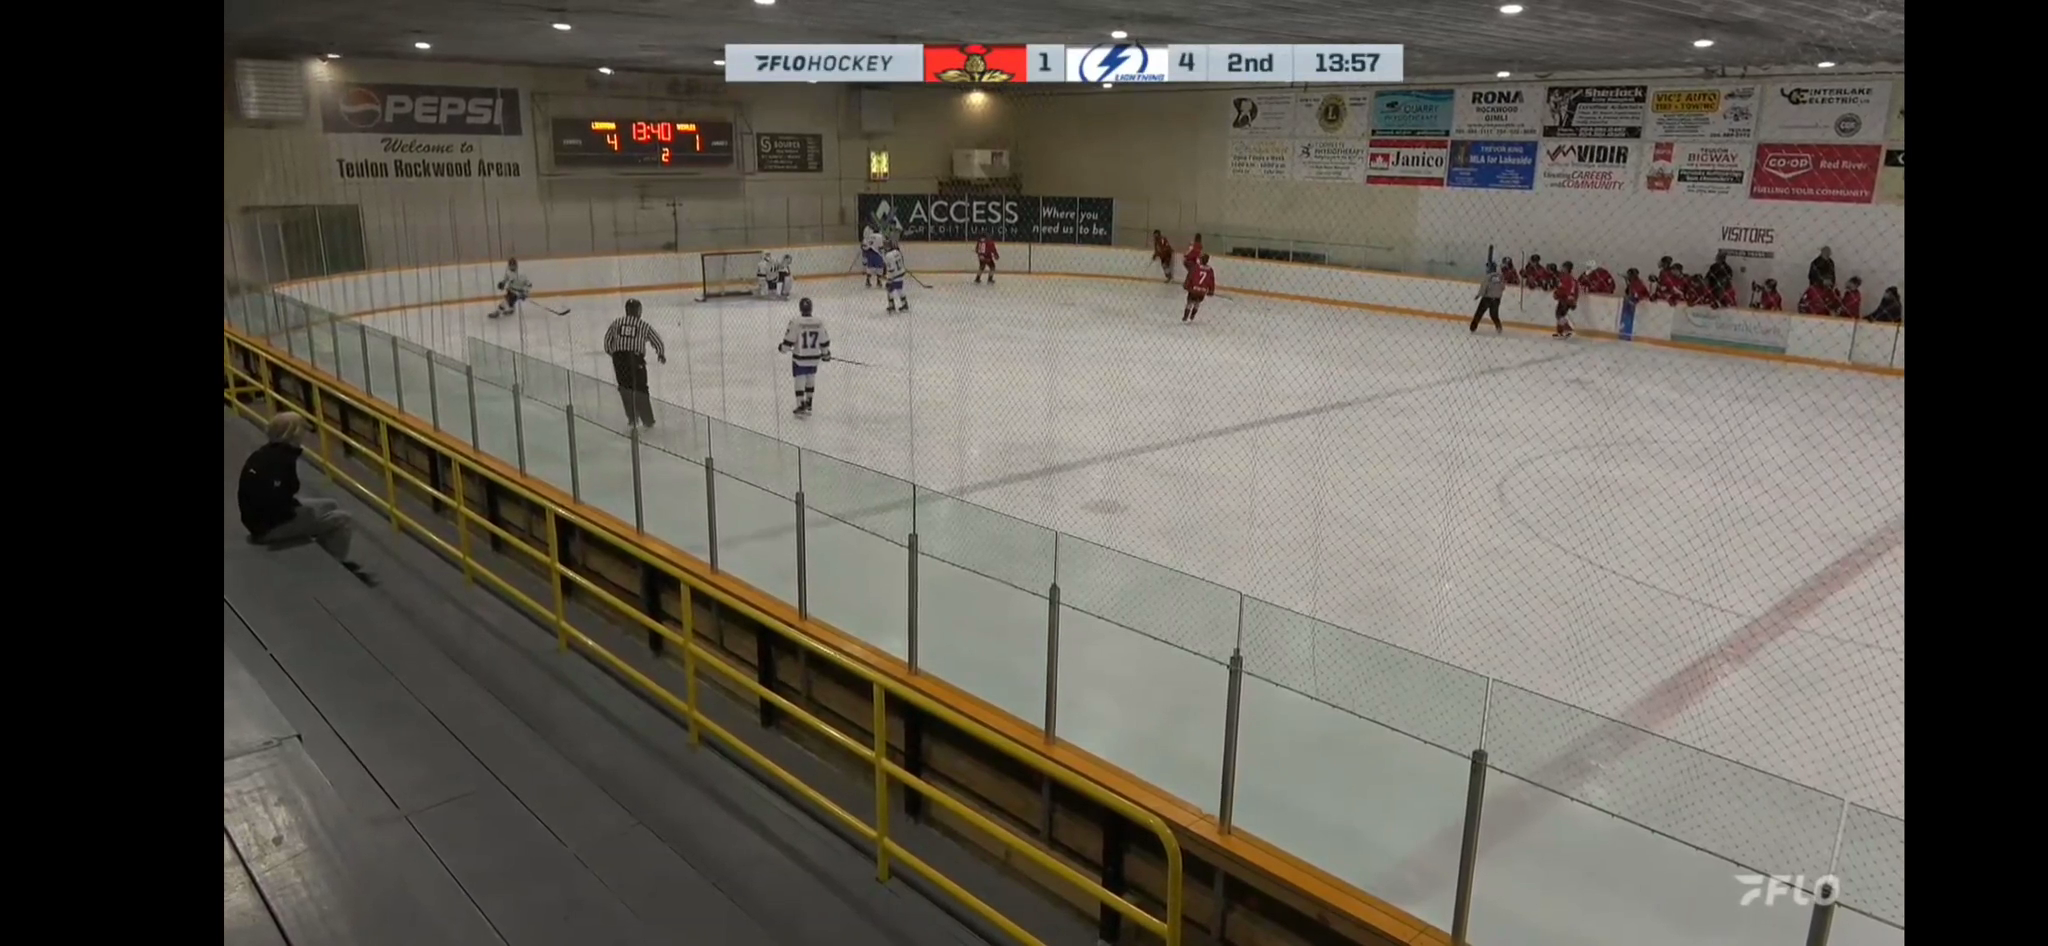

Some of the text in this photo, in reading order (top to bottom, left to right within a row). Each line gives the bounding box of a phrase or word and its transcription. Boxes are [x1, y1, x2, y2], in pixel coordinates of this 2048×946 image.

[1471, 90, 1525, 105] RONA
[1584, 87, 1643, 97] Sherlock
[1685, 92, 1717, 102] AUTO
[1681, 102, 1715, 110] TOWING
[1808, 96, 1859, 104] ELECTRIC
[385, 95, 504, 125] PEPSI
[1404, 104, 1439, 113] QUARRY
[1484, 114, 1508, 122] GIMLI
[632, 121, 671, 141] 13:40
[380, 137, 473, 154] Welcome to
[606, 133, 618, 151] 4
[661, 147, 669, 162] 2
[1480, 145, 1506, 153] TREVOR
[1577, 145, 1629, 164] VIDIR
[1391, 150, 1444, 168] Janico
[1469, 154, 1533, 165] MLA for Lakeside
[1688, 153, 1738, 163] BIGWAY
[1820, 160, 1840, 169] Red
[336, 158, 520, 178] Teulon Rockwood Arena
[1571, 170, 1613, 180] CAREERS
[1753, 186, 1870, 197] FUELLING YOUR COMMUNITY
[909, 200, 1019, 223] ACCESS
[1042, 205, 1099, 223] Where you
[907, 225, 1019, 235] CREDIT UNION
[1032, 222, 1107, 235] need us to be.
[1721, 226, 1775, 243] VISITORS
[1199, 271, 1207, 285] 7
[801, 330, 819, 349] 17
